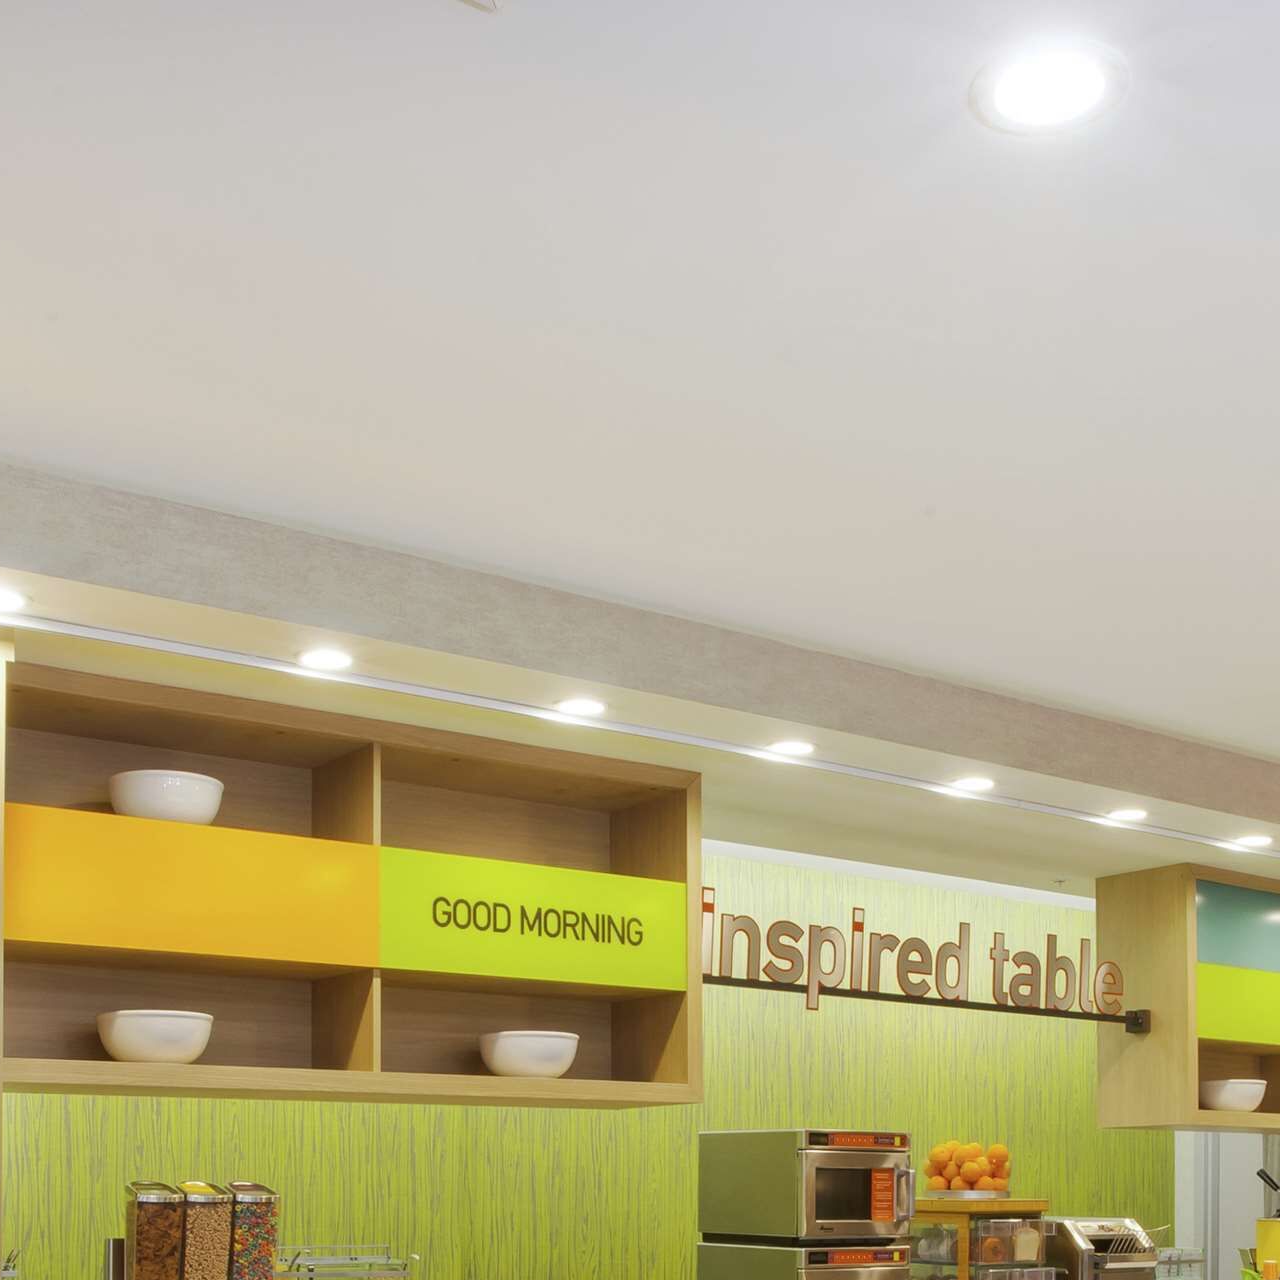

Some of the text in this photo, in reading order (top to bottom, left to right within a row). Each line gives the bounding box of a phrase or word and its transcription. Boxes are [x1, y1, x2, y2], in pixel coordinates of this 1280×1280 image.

[432, 896, 644, 946] GOOD MORNING
[702, 887, 1124, 1016] inspired table
